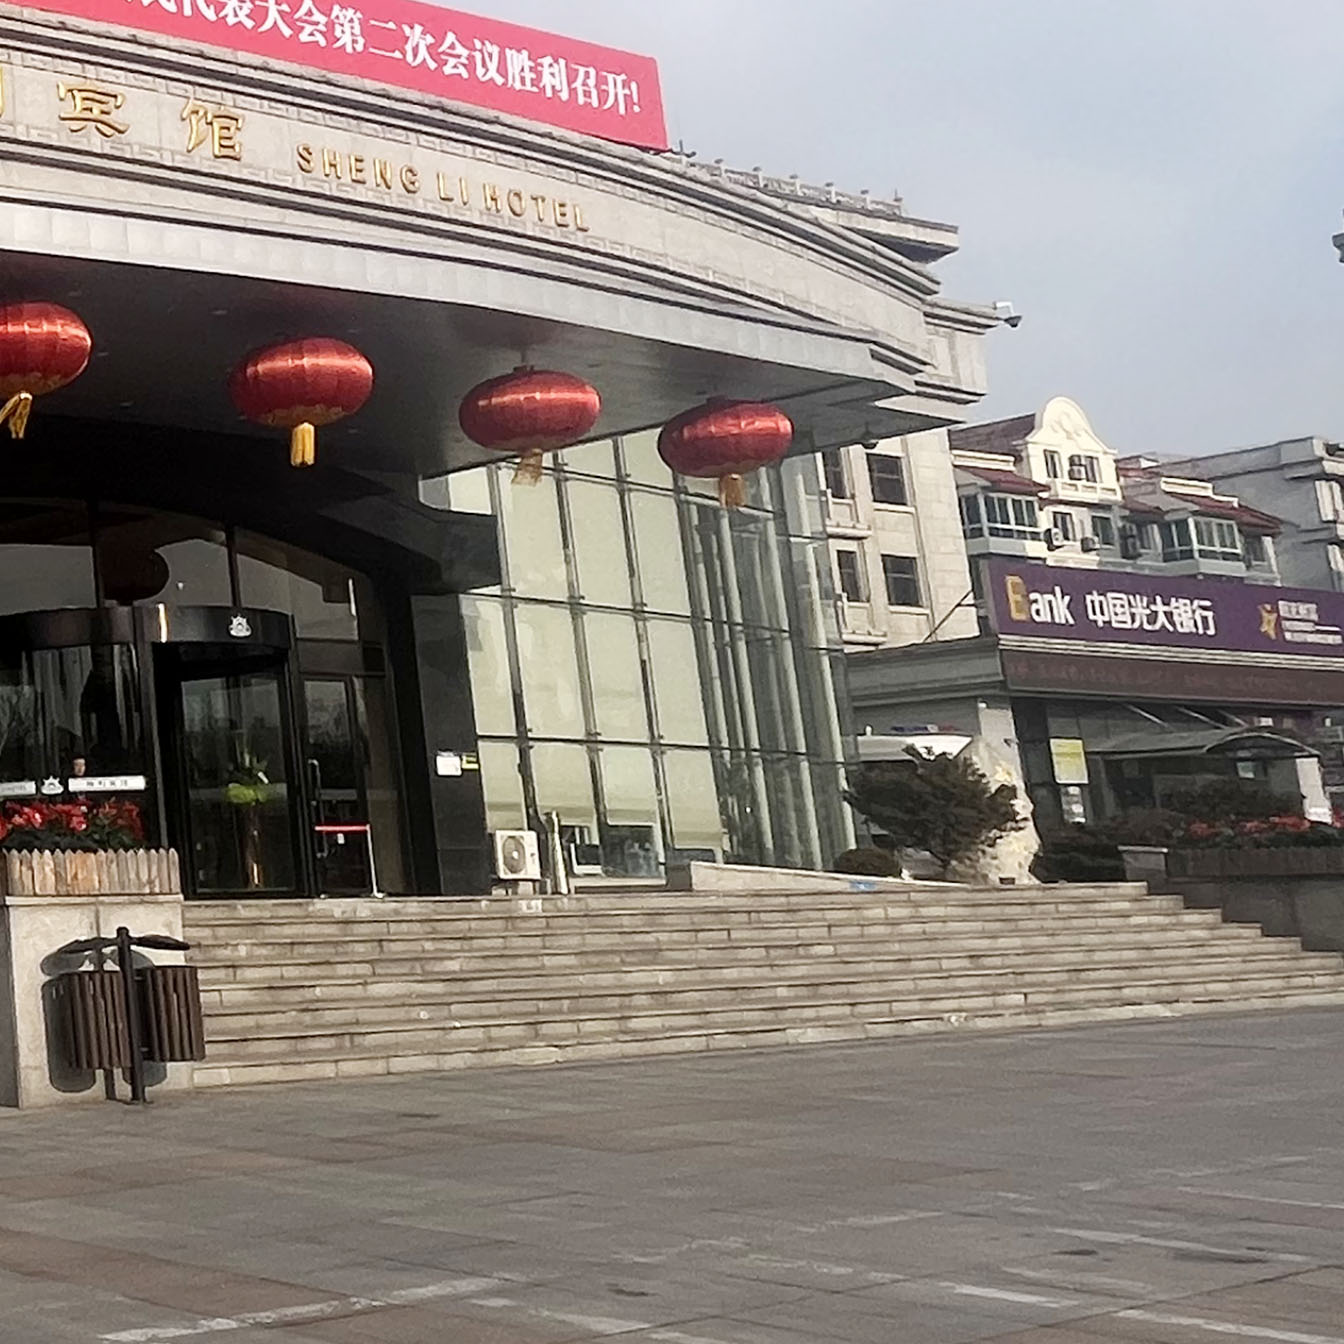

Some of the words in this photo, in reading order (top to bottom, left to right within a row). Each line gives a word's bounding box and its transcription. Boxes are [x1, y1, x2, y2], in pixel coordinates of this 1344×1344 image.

[296, 143, 419, 194] SHENG
[437, 171, 469, 205] LI
[482, 182, 590, 232] HOTEL
[1085, 590, 1216, 636] 中国光大银行
